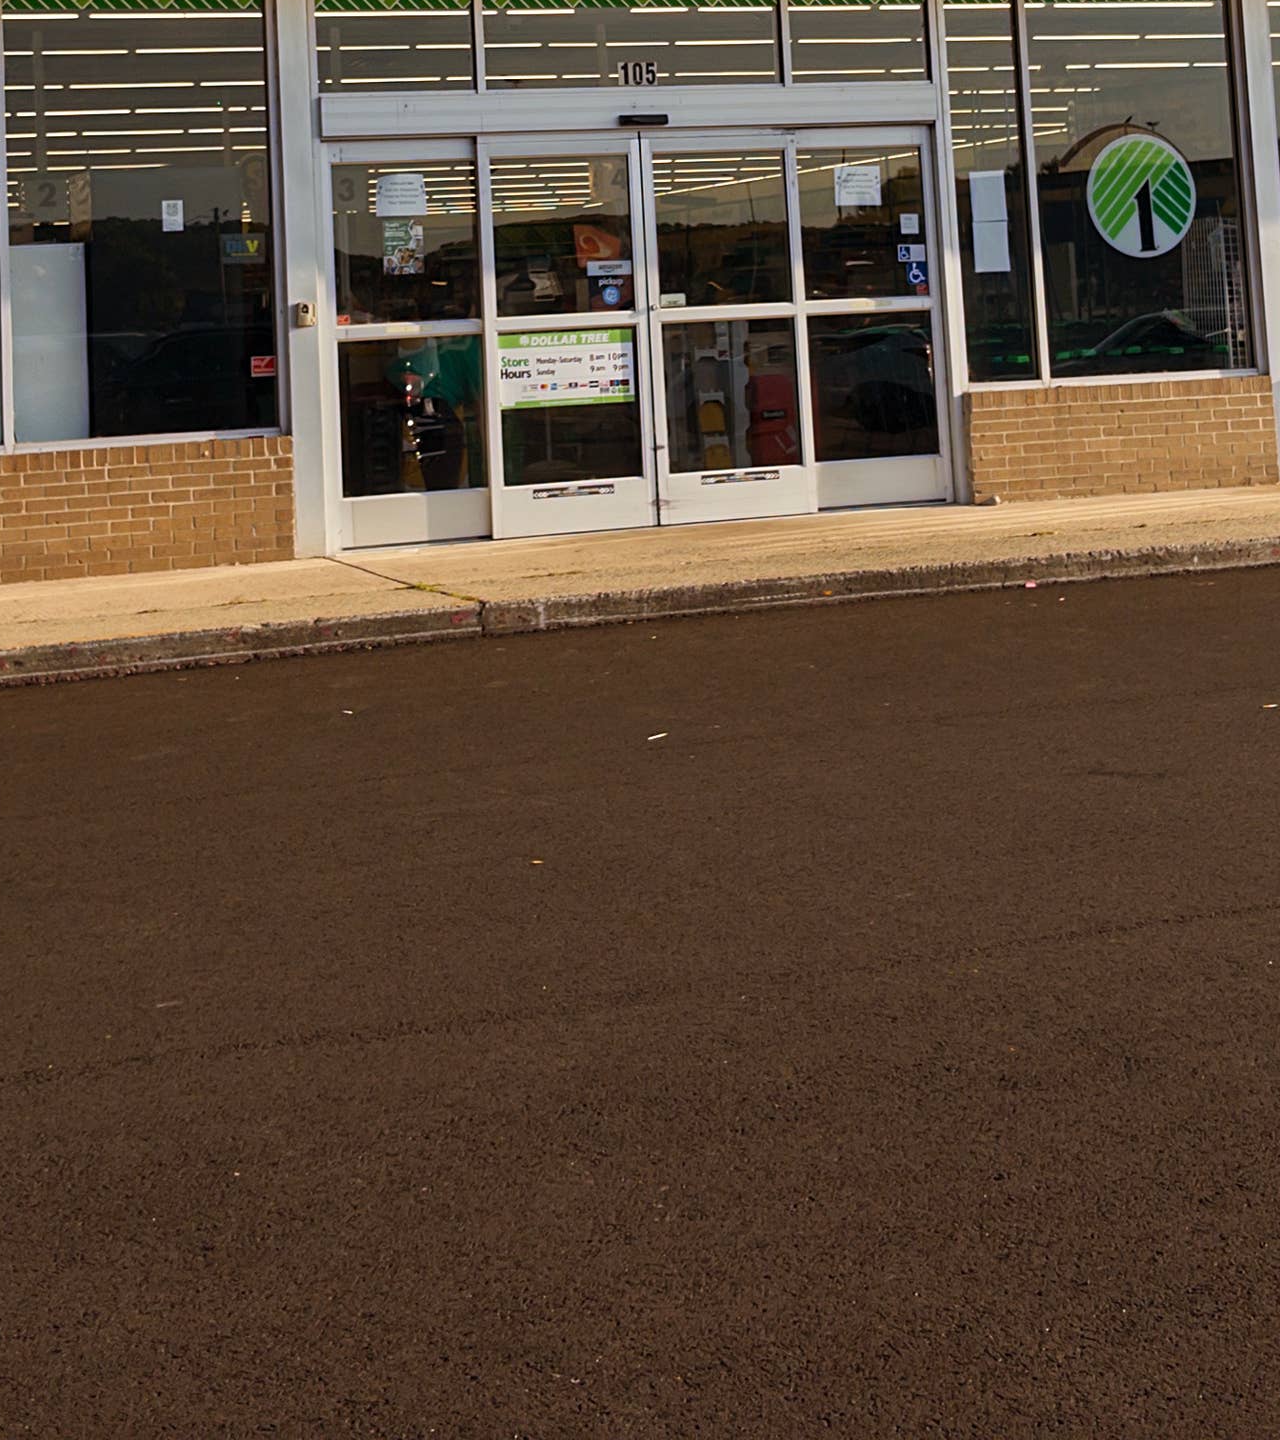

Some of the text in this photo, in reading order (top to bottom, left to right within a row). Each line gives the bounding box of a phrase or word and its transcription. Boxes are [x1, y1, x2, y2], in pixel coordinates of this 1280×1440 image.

[621, 62, 656, 85] 105
[530, 333, 609, 346] DOLLAR TREE
[501, 356, 529, 368] Store
[500, 368, 532, 380] Hours
